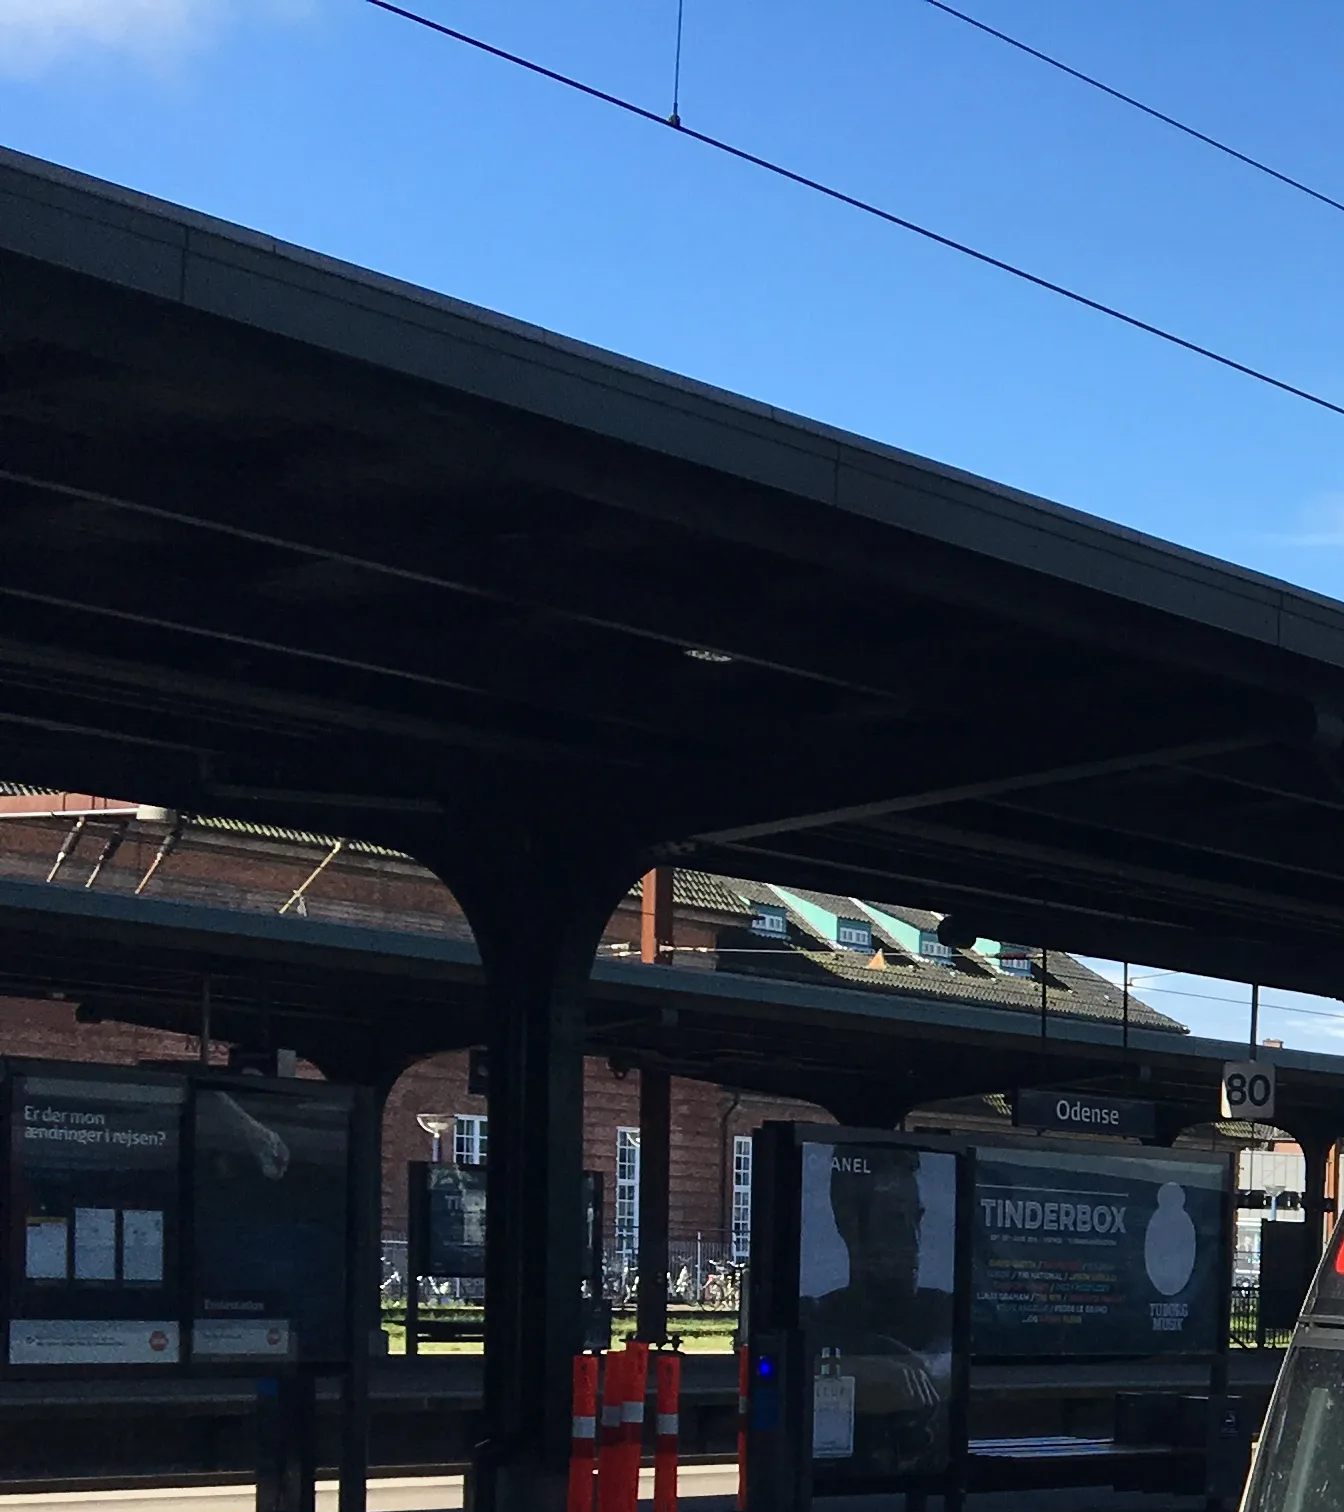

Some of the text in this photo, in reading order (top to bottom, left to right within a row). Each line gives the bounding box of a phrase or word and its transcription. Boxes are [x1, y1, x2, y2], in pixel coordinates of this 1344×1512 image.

[1227, 1073, 1271, 1107] 80
[24, 1105, 105, 1125] Er der mon
[1056, 1099, 1119, 1126] Odense
[24, 1125, 101, 1145] ændringer
[113, 1130, 166, 1148] rejsen?
[980, 1197, 1127, 1234] TINDERBOX
